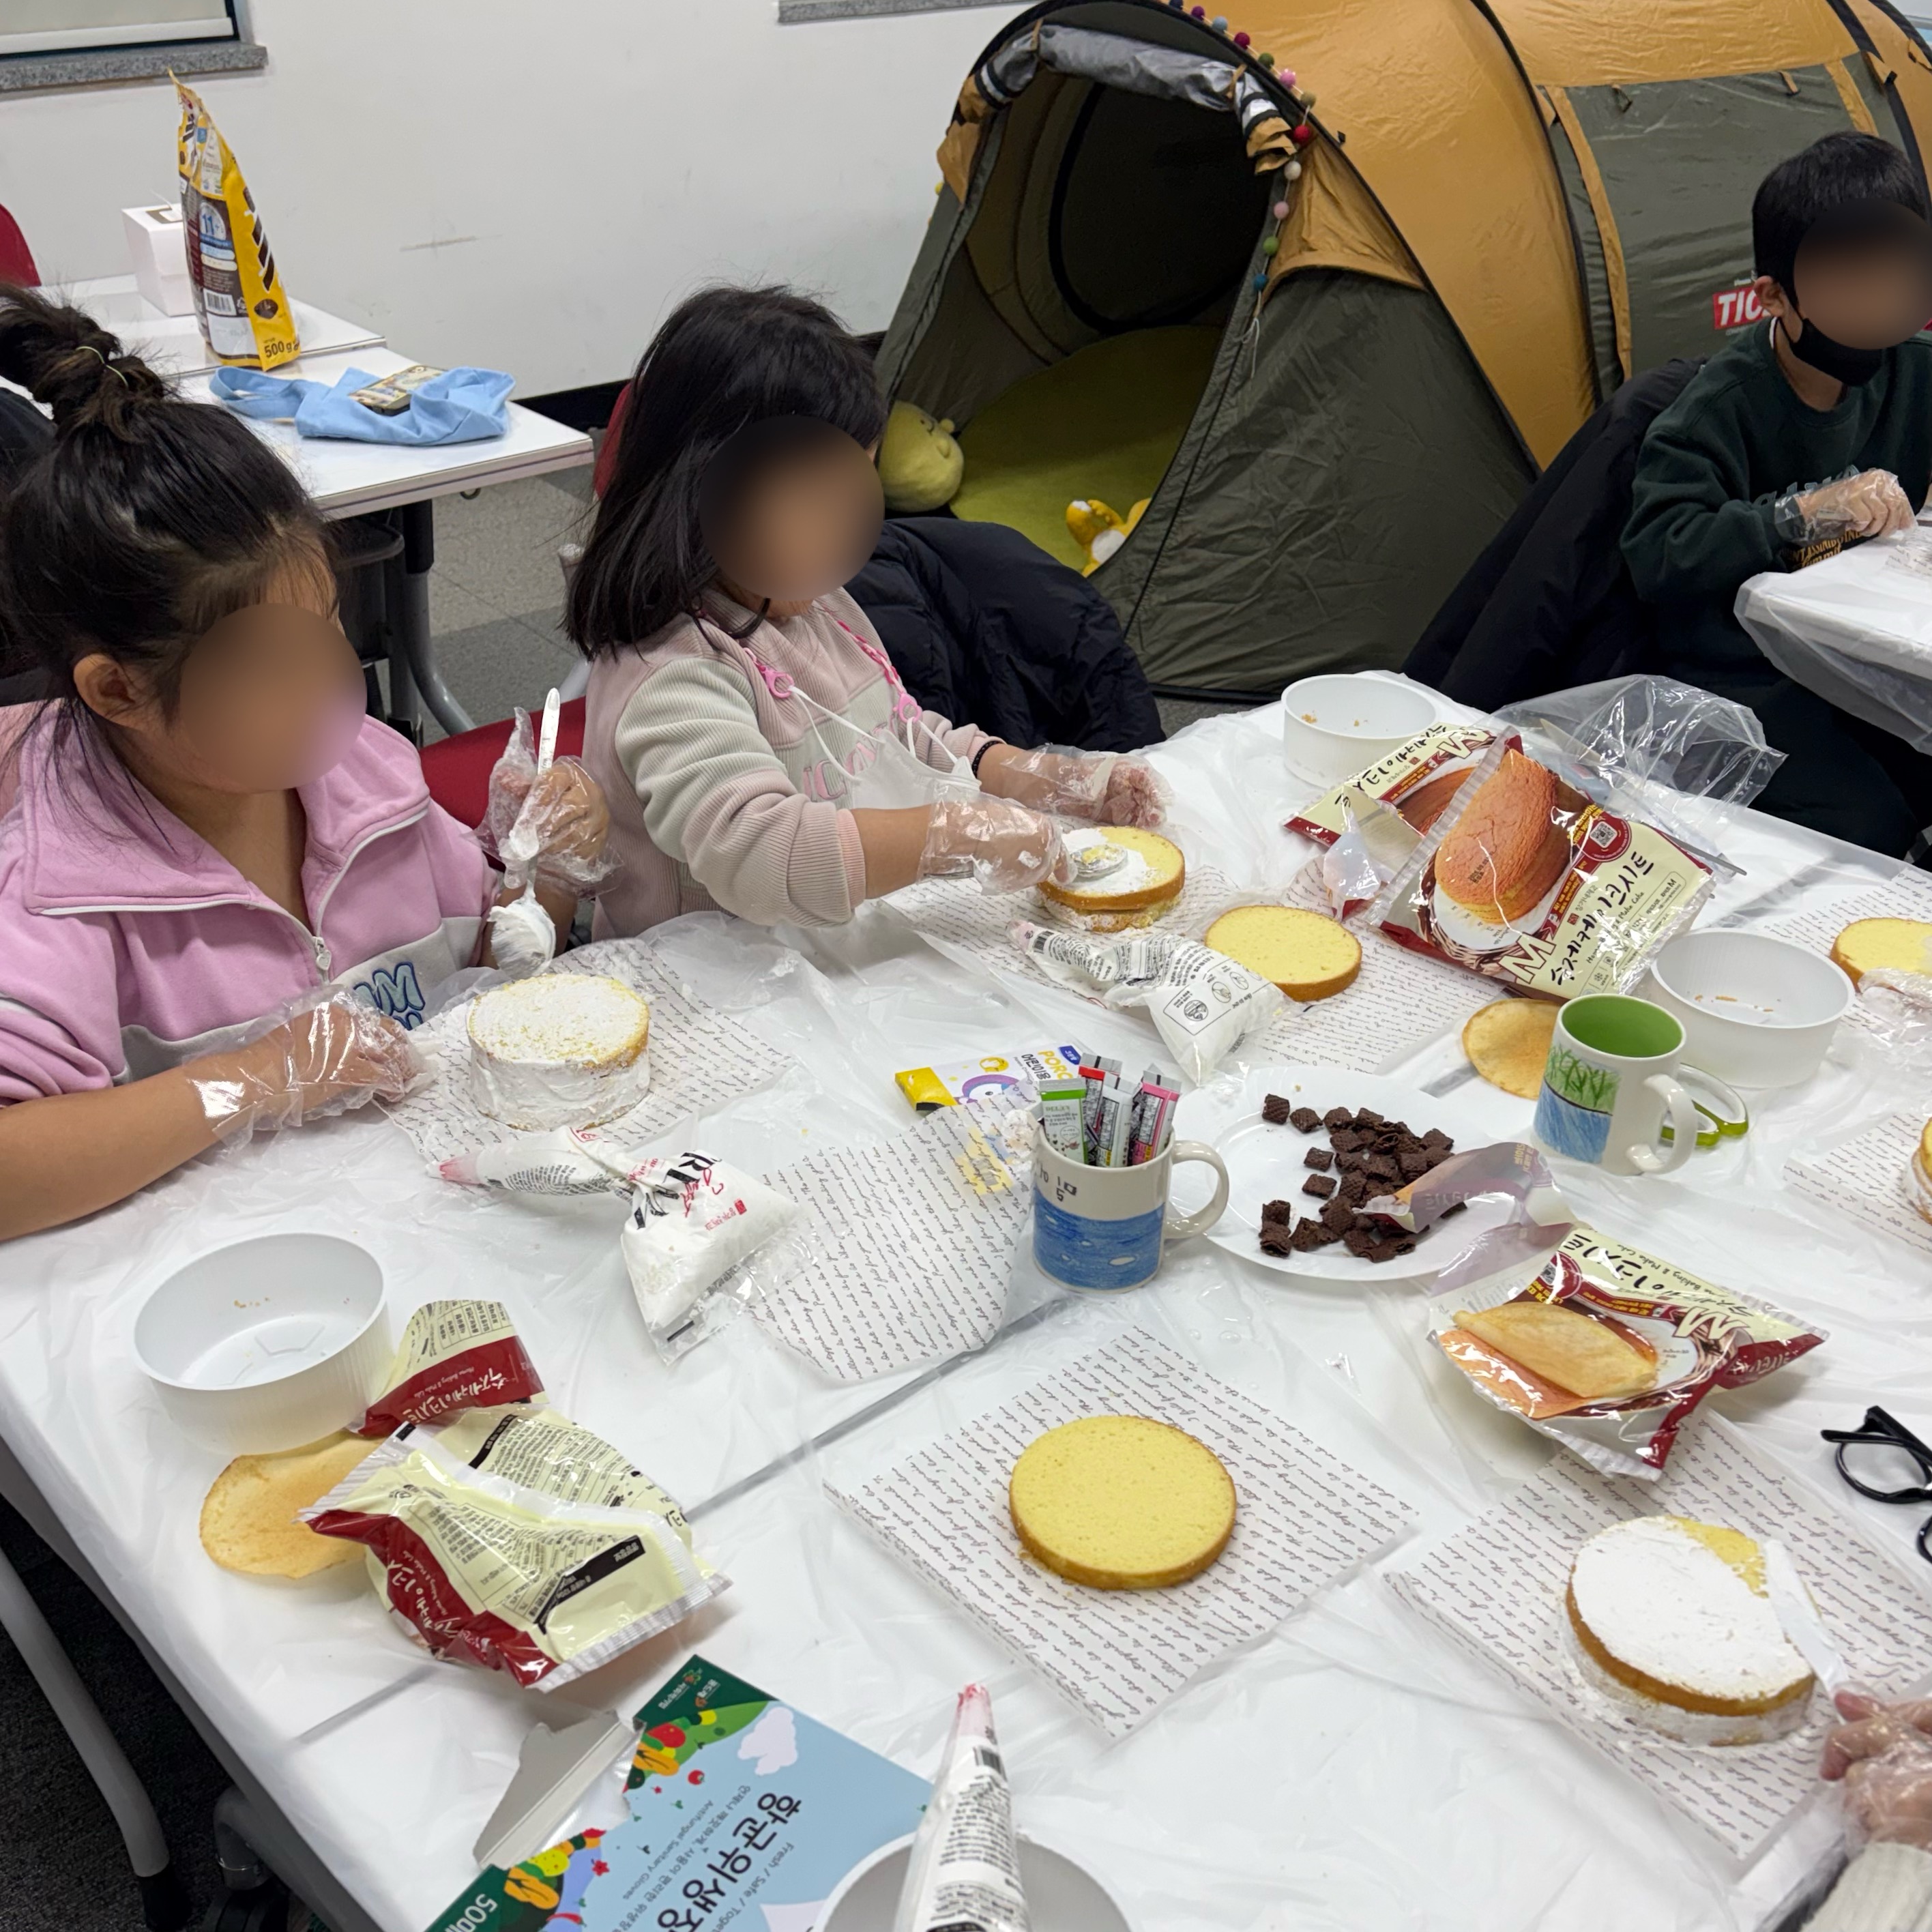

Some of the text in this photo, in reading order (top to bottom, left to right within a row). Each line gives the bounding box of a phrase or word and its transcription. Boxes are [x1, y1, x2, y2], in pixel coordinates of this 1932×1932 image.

[1718, 289, 1772, 327] TIC
[264, 340, 284, 358] 500
[1618, 902, 1633, 920] Make
[1629, 888, 1644, 904] Cake
[1499, 933, 1556, 984] M
[1021, 1055, 1051, 1080] 어린이용
[1614, 1240, 1636, 1259] Cake
[1637, 1251, 1661, 1272] Make
[1670, 1268, 1701, 1294] Baking
[401, 1367, 506, 1424] 수제케이크시트
[726, 1784, 751, 1812] 언제나
[622, 1800, 714, 1901] Antifungal Sanitary Gloves
[671, 1847, 697, 1876] 사용이
[771, 1841, 795, 1869] Fresh
[643, 1874, 673, 1904] 편리한
[742, 1874, 767, 1899] Safe
